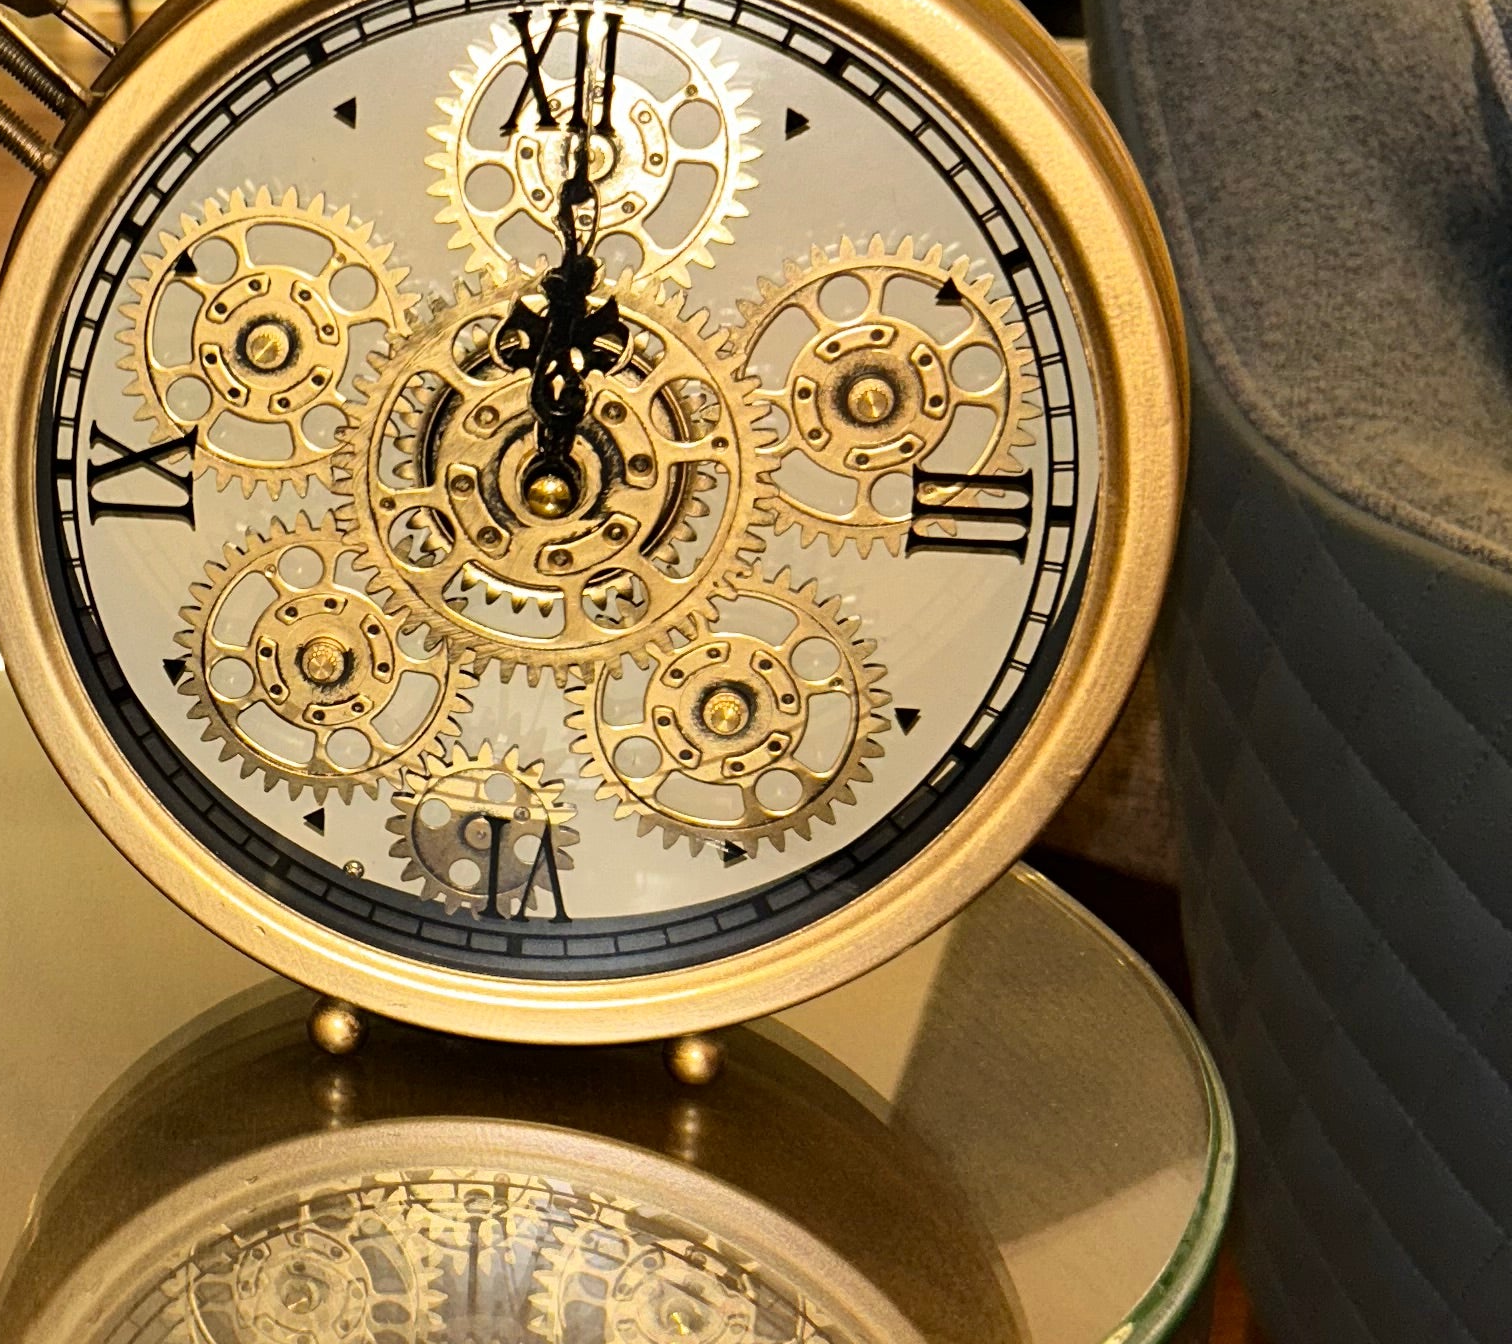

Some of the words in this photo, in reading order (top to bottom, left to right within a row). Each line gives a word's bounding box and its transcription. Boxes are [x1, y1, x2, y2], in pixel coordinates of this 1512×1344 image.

[500, 8, 624, 137] XII
[87, 420, 199, 531] IX
[905, 463, 1033, 565] III
[478, 815, 573, 923] VI
